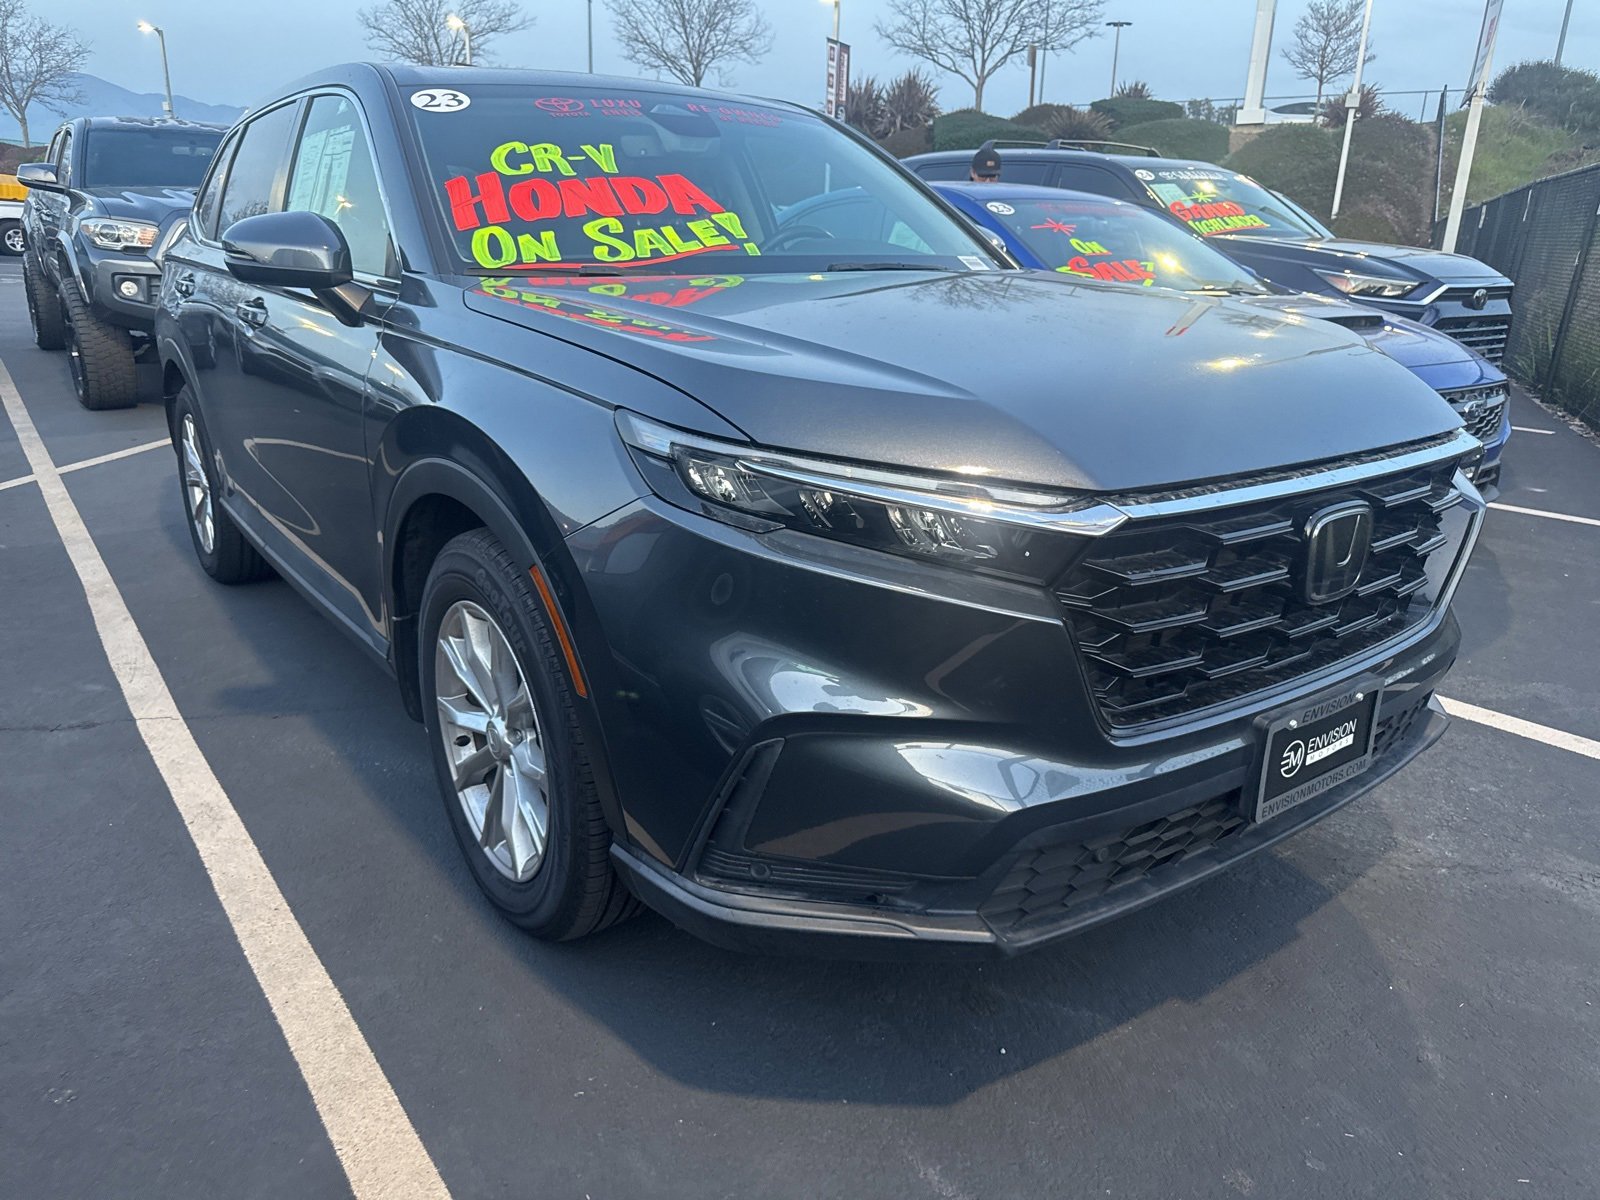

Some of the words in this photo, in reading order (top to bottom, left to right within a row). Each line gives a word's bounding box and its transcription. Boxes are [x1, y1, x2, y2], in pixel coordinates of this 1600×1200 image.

[417, 93, 464, 108] 23
[490, 141, 619, 176] CR-V
[445, 171, 726, 231] HONDA
[583, 211, 761, 262] SALE!
[1302, 692, 1356, 722] ENVISION
[1307, 718, 1358, 753] ENVISION
[1261, 758, 1367, 818] ENVISIONMOTORS.COM
